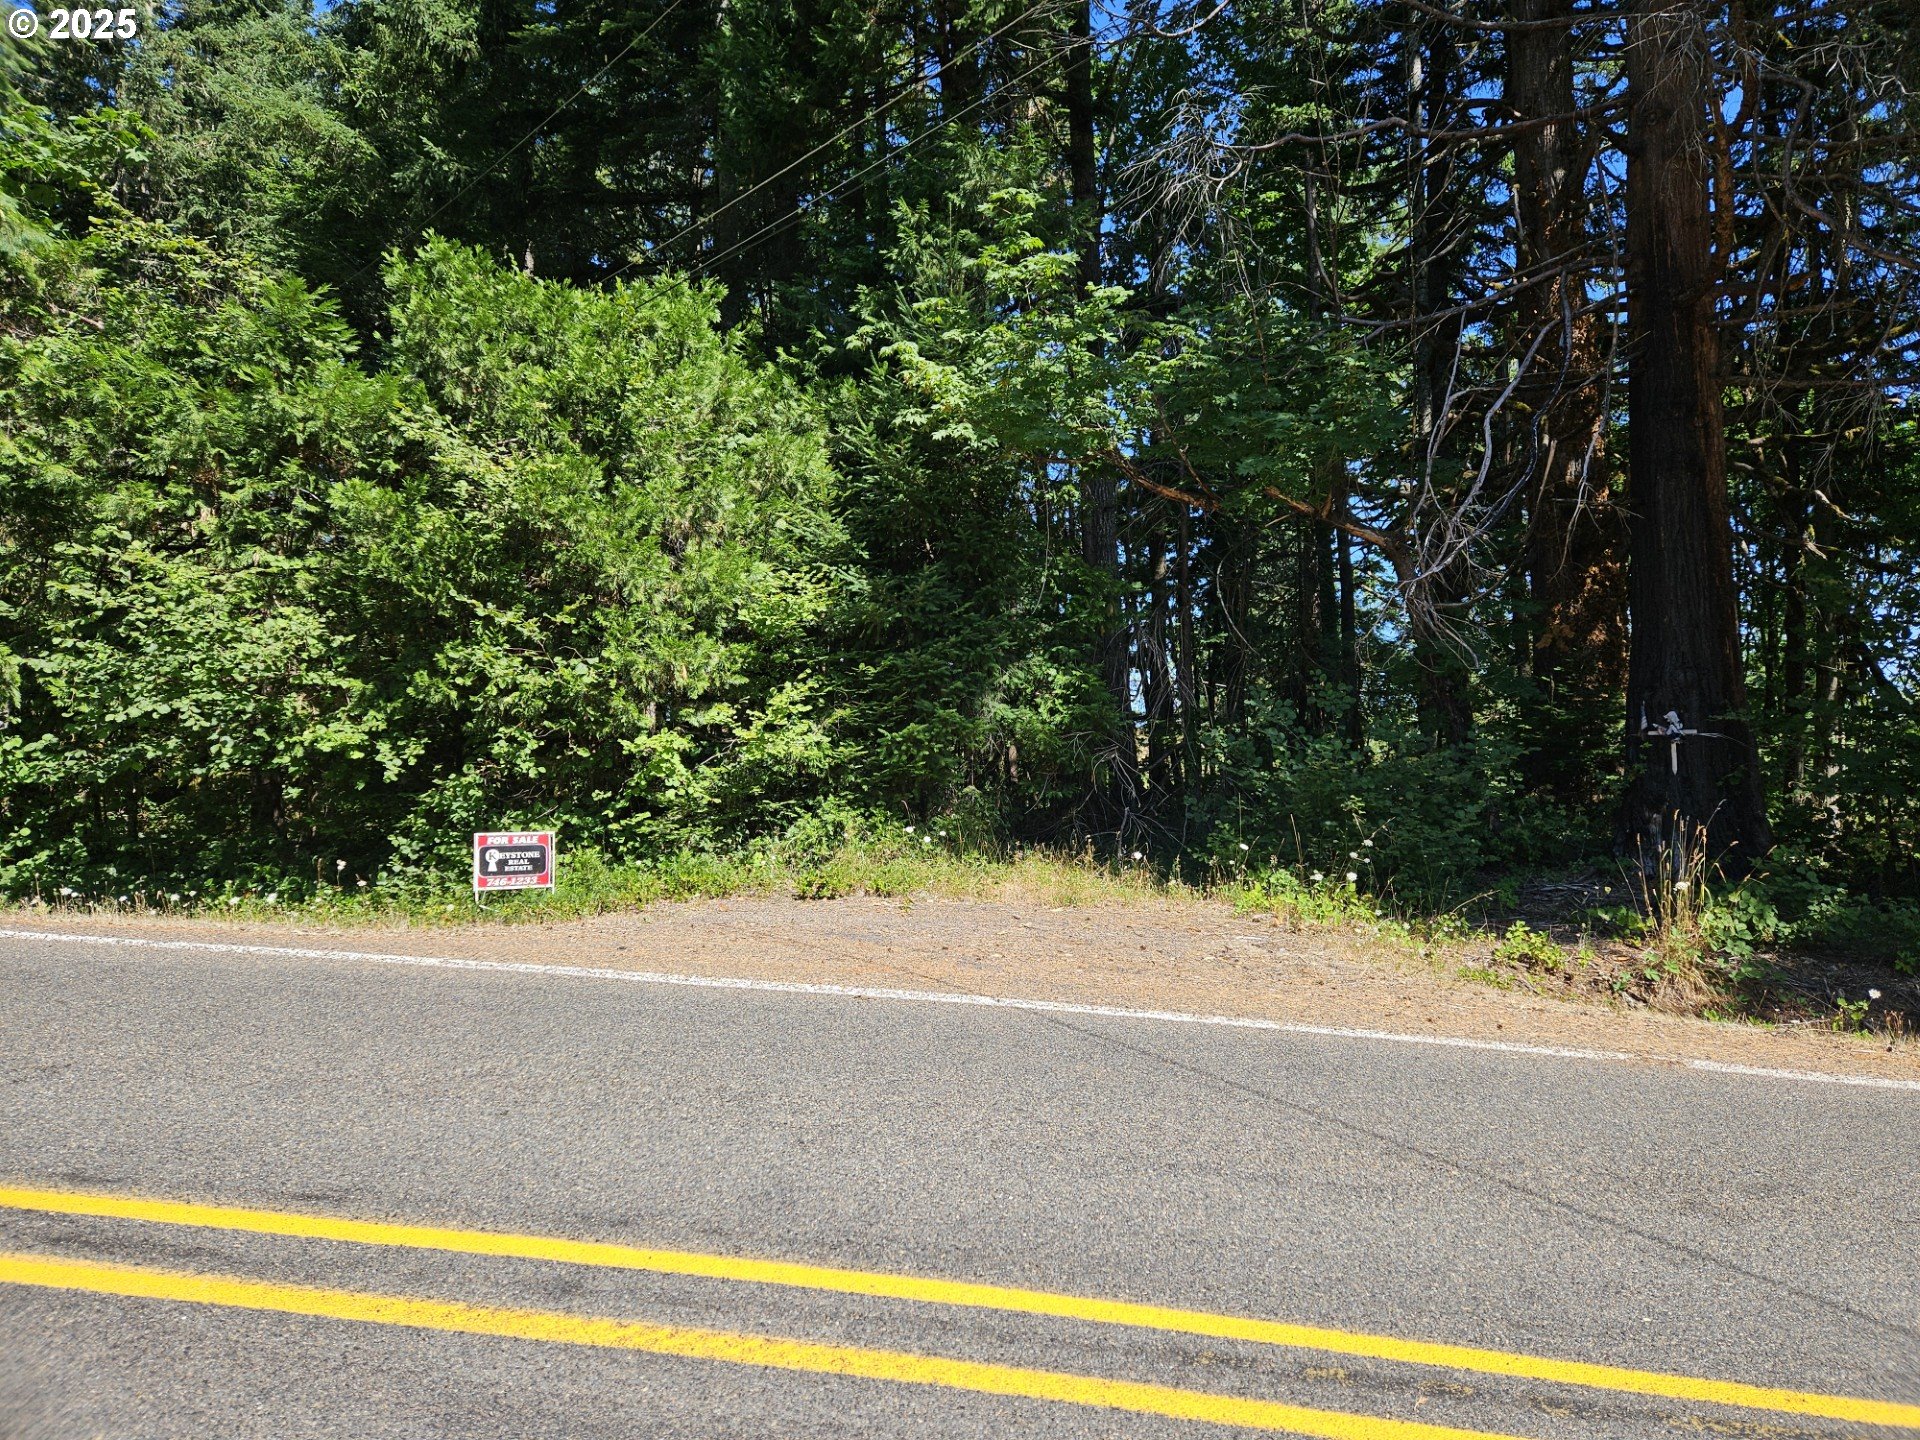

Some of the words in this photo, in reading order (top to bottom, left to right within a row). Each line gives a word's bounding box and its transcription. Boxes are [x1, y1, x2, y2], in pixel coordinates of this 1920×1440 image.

[486, 836, 508, 845] FOR
[512, 835, 538, 844] SALE
[487, 851, 540, 860] KEYSTONE
[486, 876, 537, 886] 746-1233
